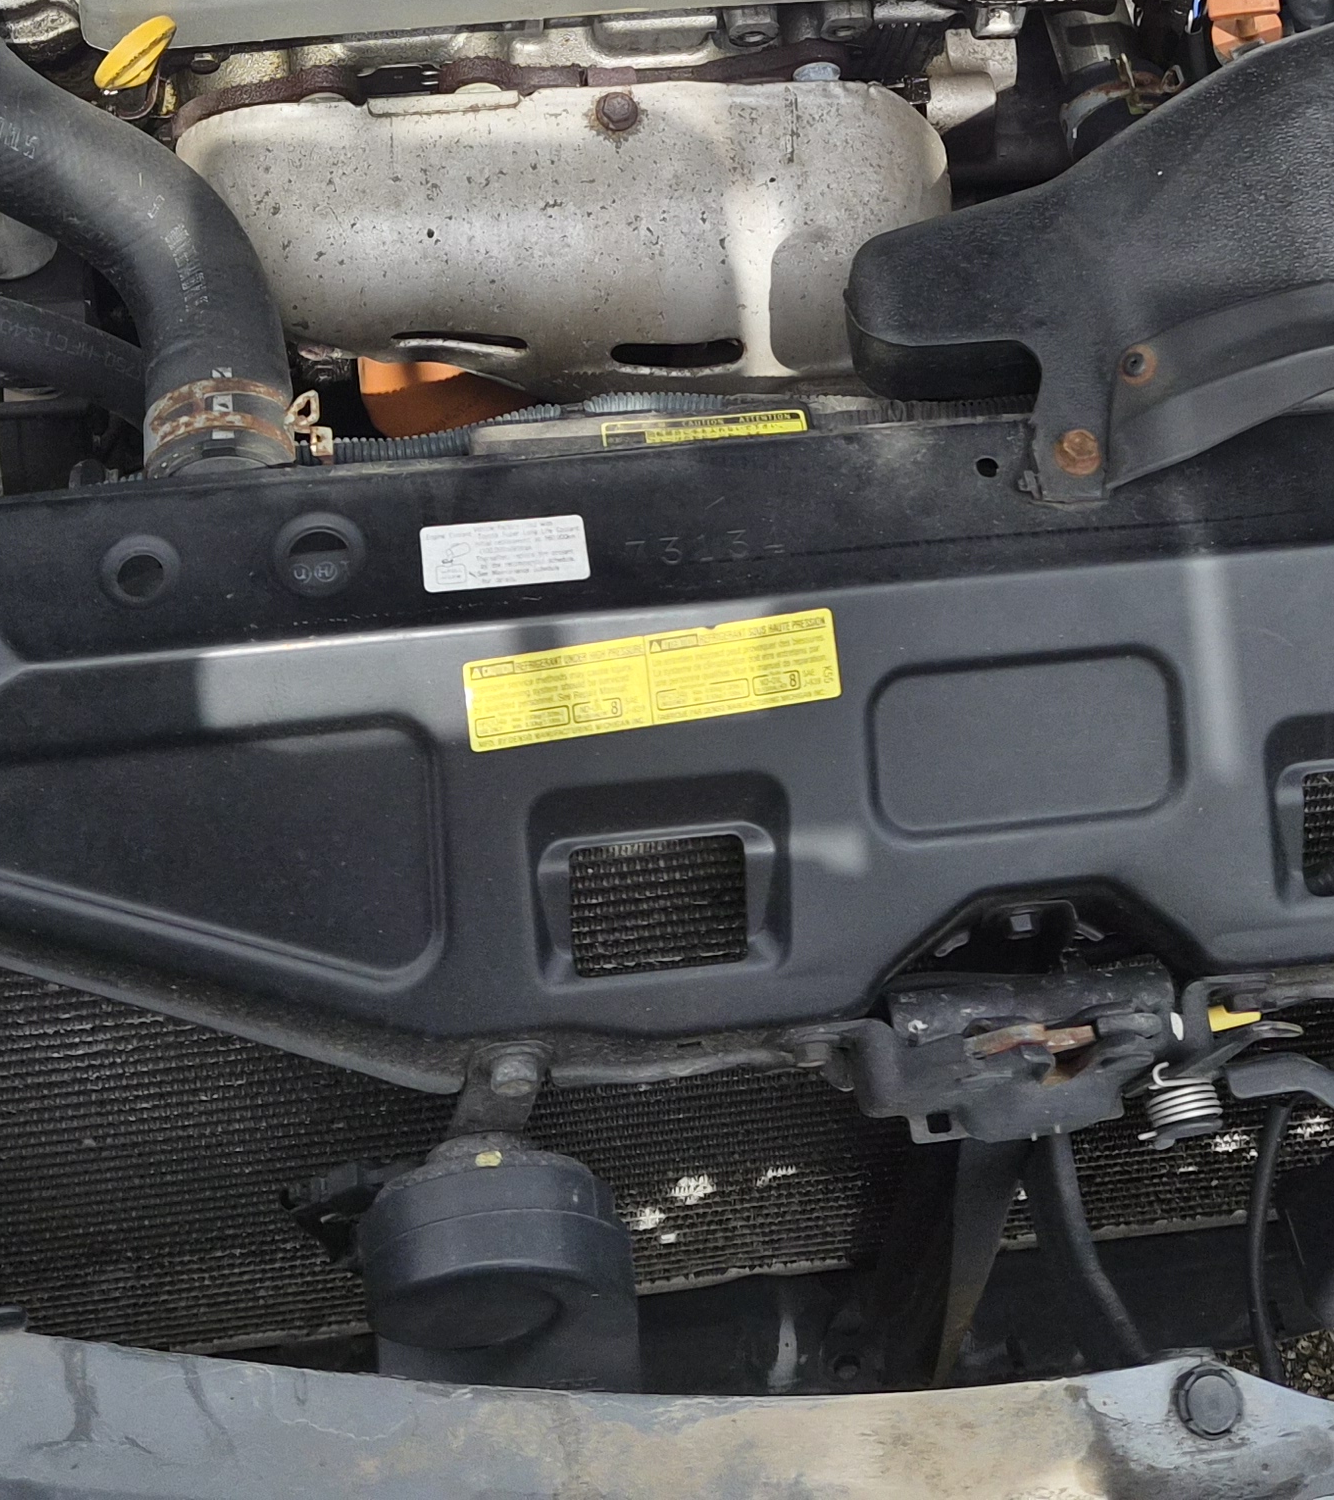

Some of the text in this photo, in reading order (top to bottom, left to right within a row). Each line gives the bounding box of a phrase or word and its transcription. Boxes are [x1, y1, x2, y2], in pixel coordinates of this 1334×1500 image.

[681, 411, 792, 428] CAUTION ATTENTION
[768, 622, 790, 633] HAUTE
[791, 617, 825, 630] PRESSION
[789, 673, 796, 687] 8
[610, 701, 618, 714] 8
